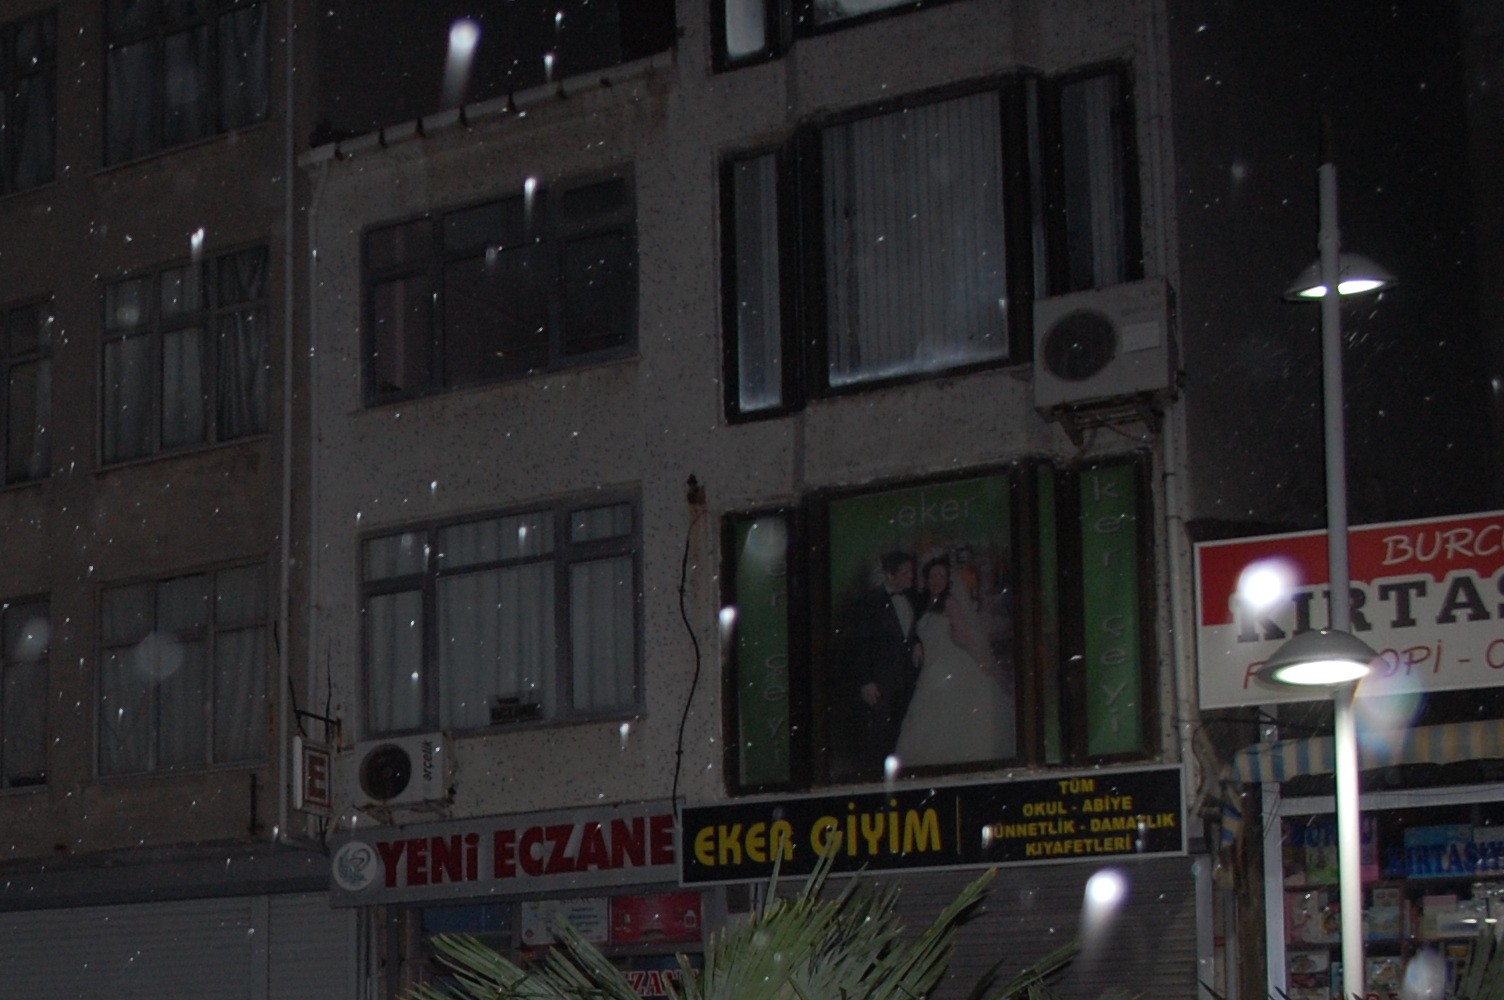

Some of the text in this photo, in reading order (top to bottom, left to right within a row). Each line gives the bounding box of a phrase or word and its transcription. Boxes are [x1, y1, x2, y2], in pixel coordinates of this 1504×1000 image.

[897, 491, 979, 528] eker
[1382, 525, 1504, 567] BURC
[307, 754, 327, 800] E
[422, 740, 433, 782] arçelik
[1059, 777, 1095, 794] TÜM
[1022, 801, 1068, 817] OKUL
[1082, 794, 1133, 813] ABİYE
[493, 814, 675, 879] ECZANE
[694, 801, 943, 867] EKER GİYİM
[983, 817, 1075, 839] ÜNNETLİK
[1025, 833, 1132, 856] KIYAFETLERİ
